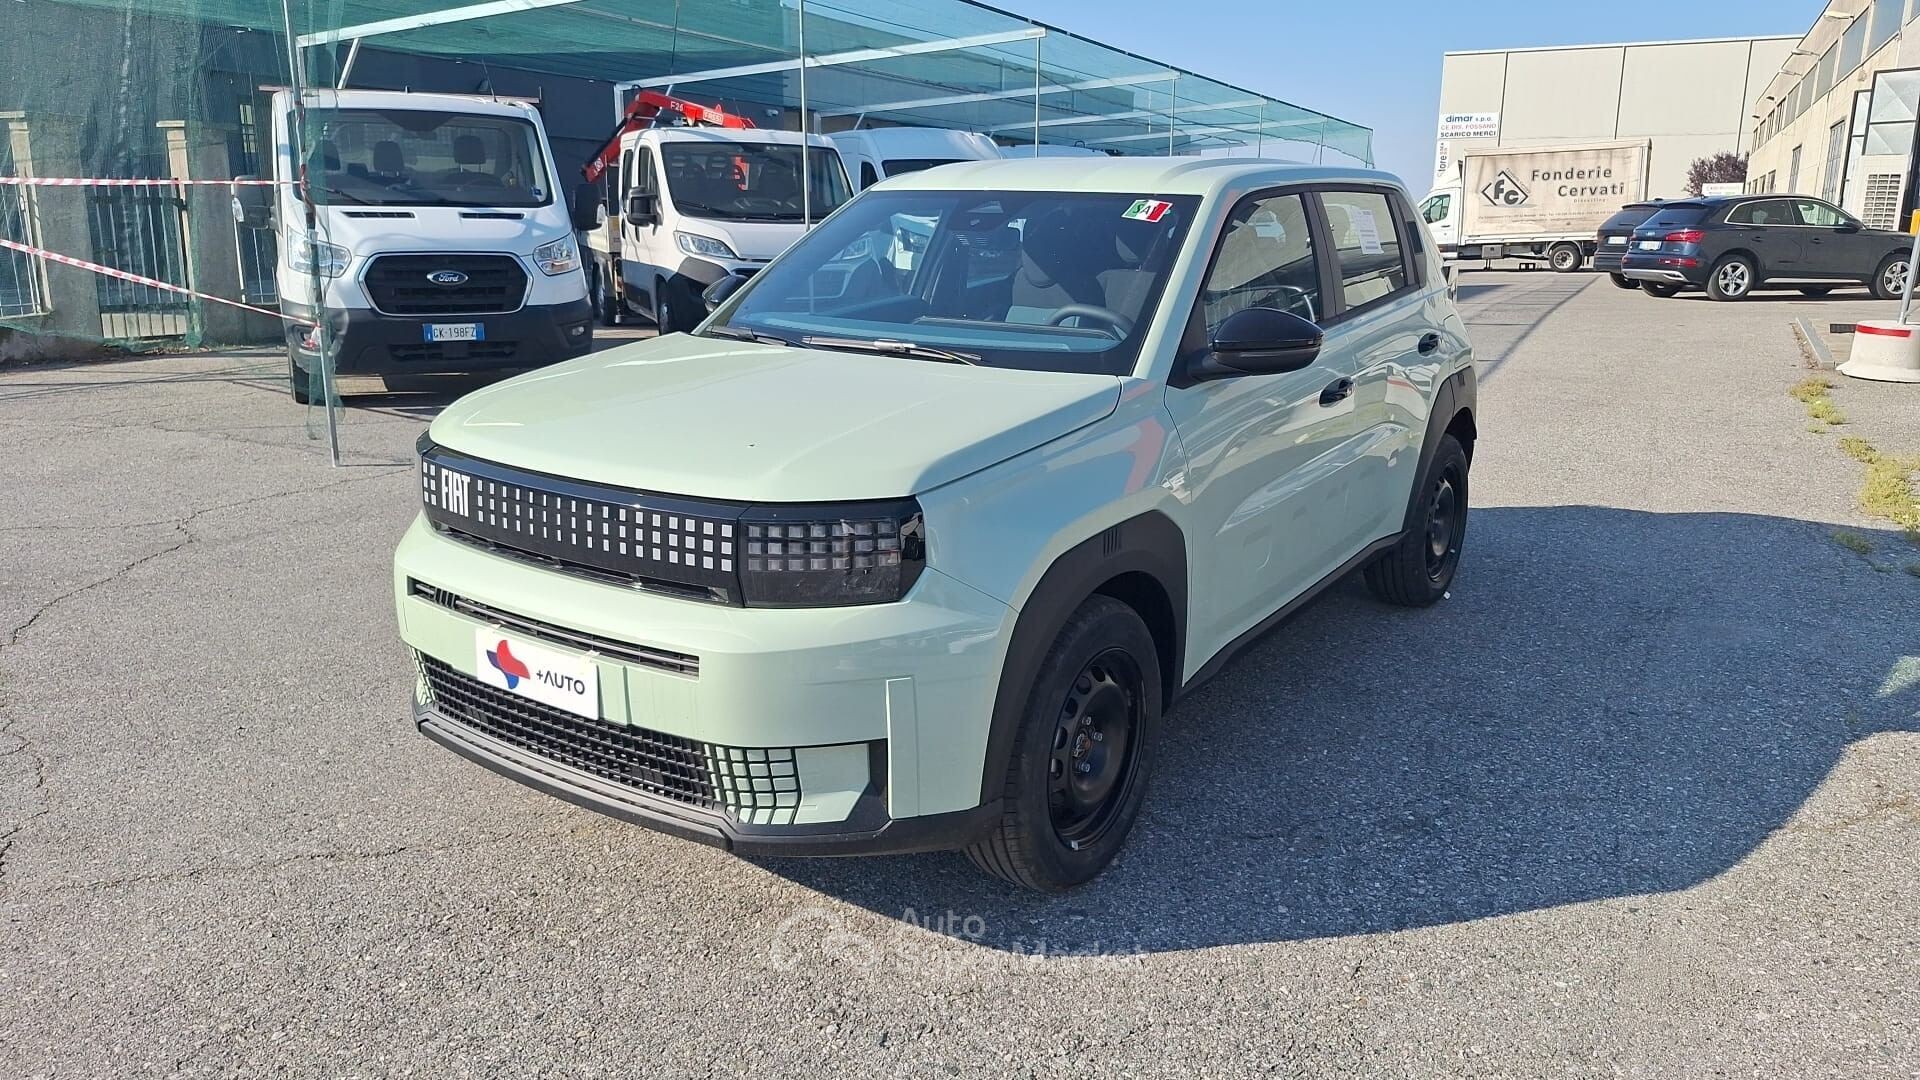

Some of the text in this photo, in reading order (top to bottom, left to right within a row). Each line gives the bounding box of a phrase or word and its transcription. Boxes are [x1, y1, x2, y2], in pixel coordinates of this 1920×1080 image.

[1445, 115, 1473, 123] dimar
[1531, 166, 1612, 182] Fonderie
[1558, 182, 1625, 197] Cervati
[438, 272, 459, 282] Ford
[440, 467, 471, 518] FIAT
